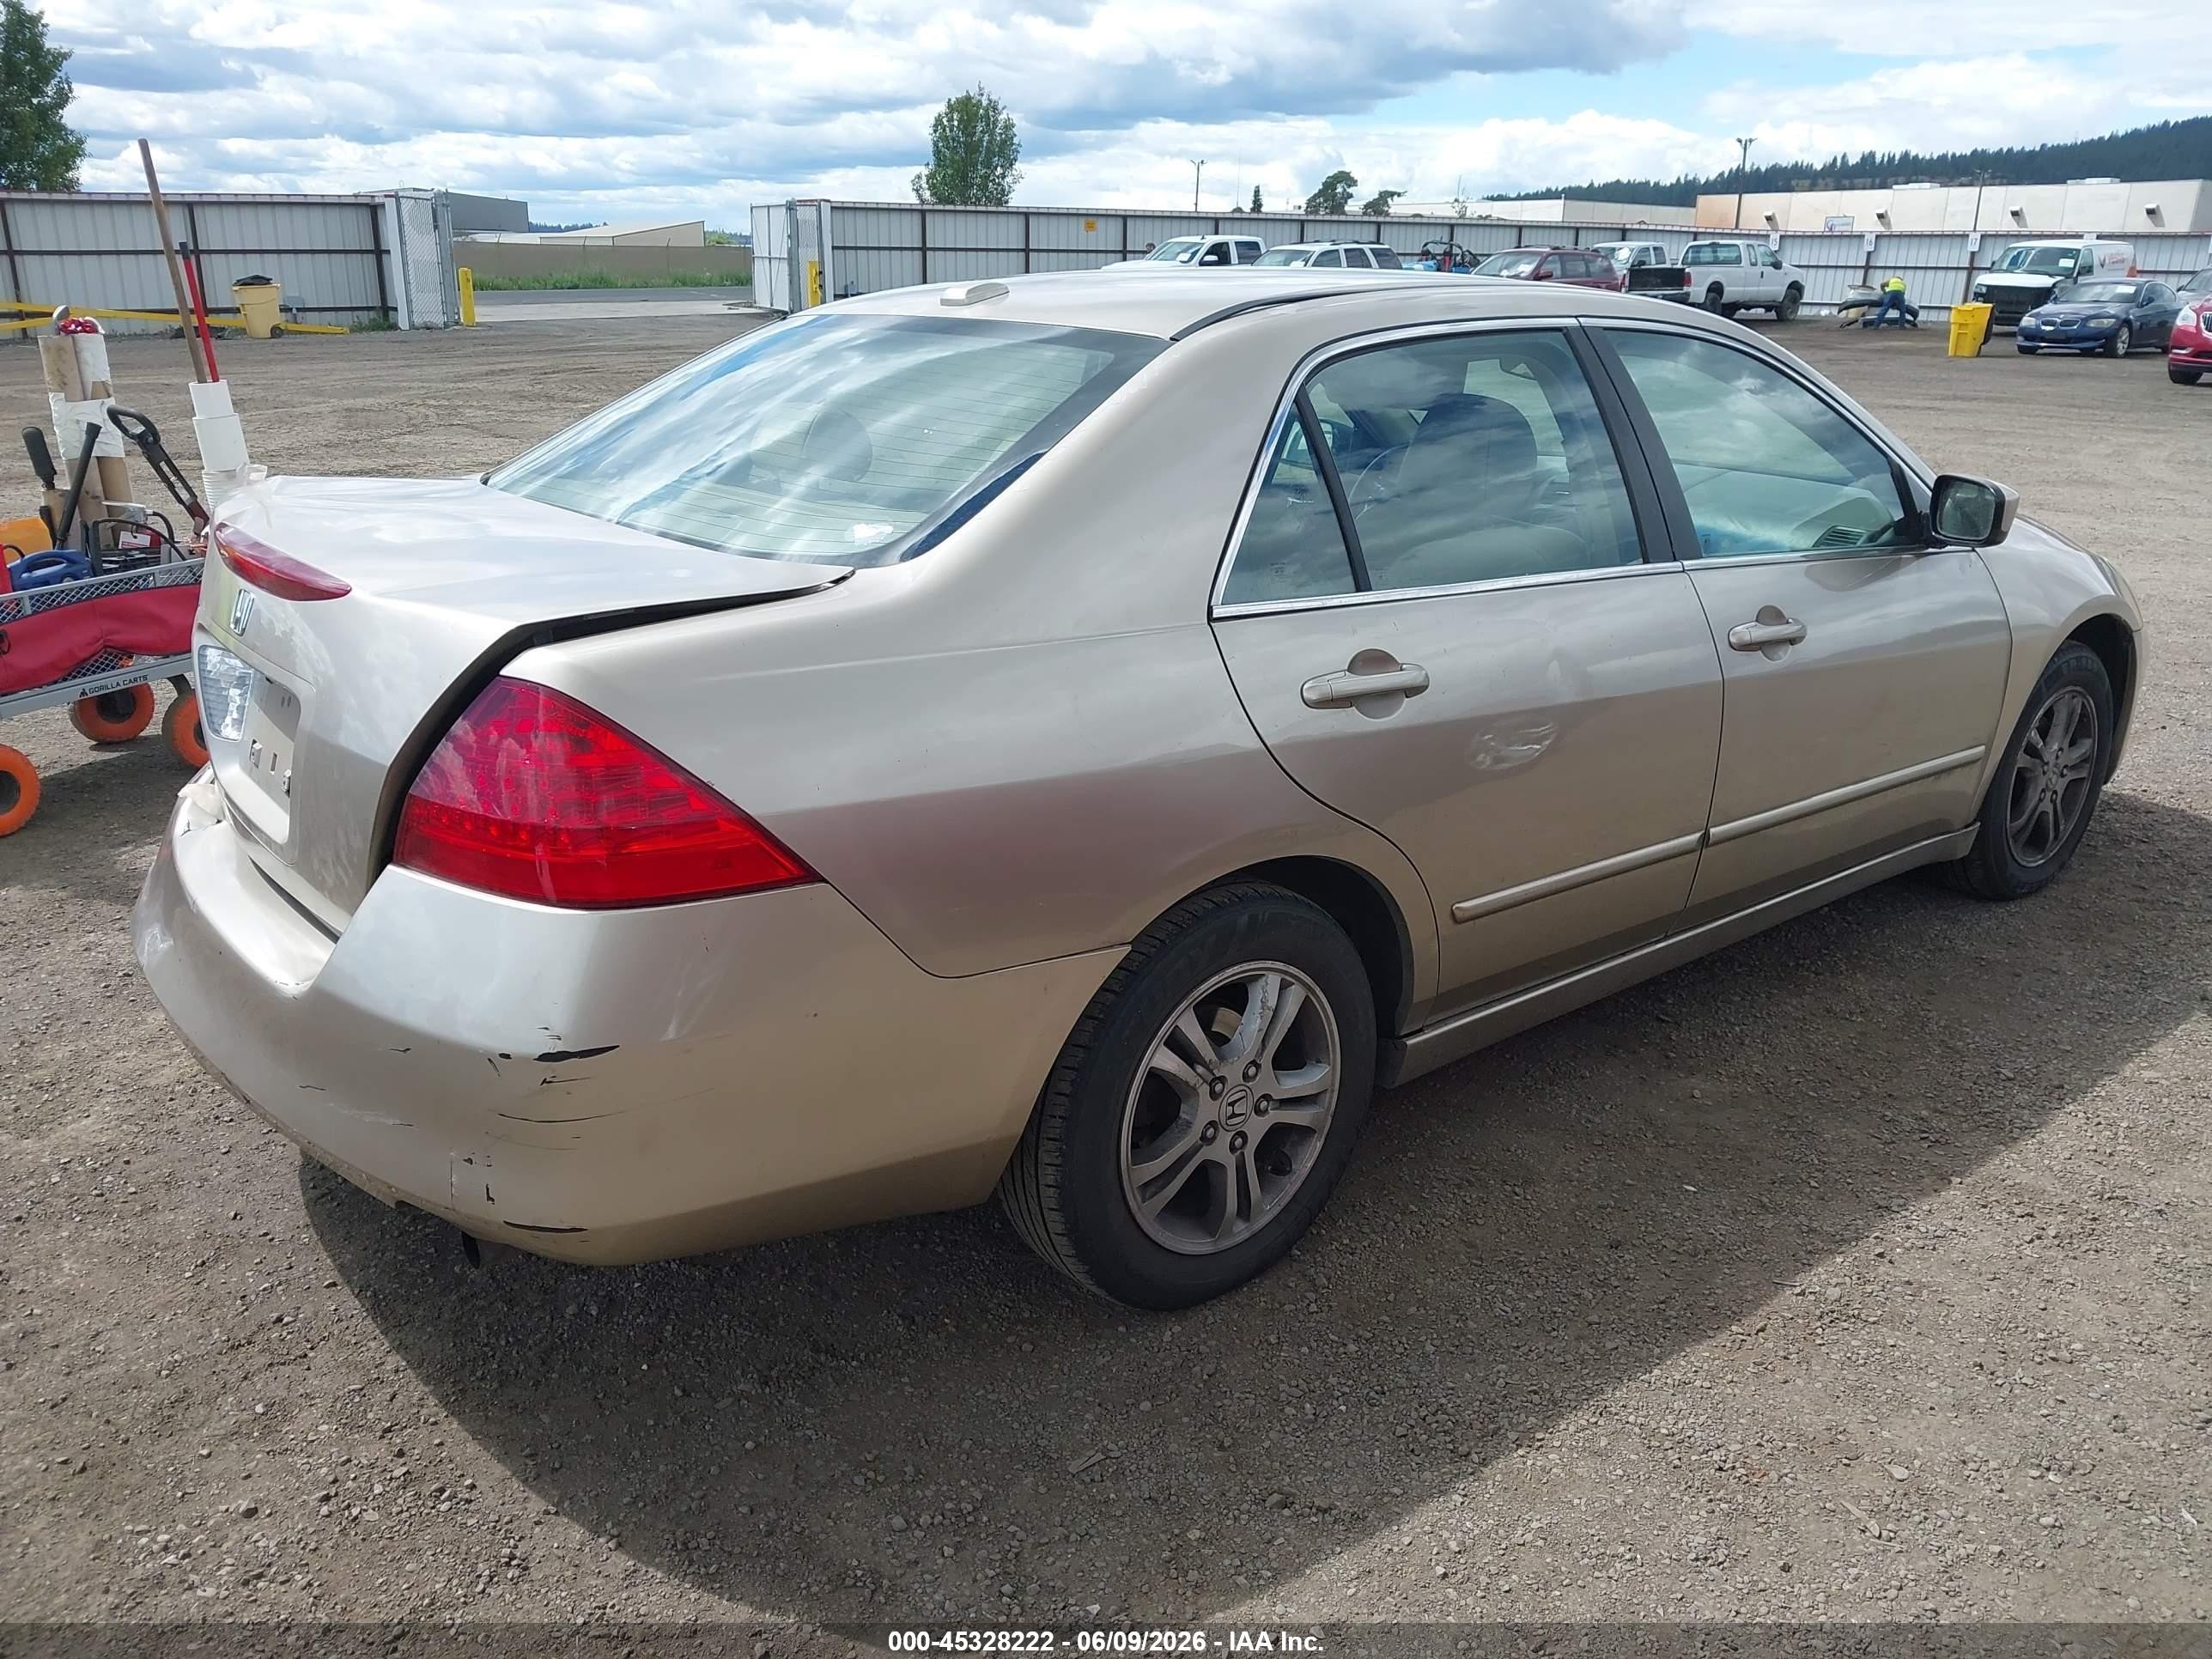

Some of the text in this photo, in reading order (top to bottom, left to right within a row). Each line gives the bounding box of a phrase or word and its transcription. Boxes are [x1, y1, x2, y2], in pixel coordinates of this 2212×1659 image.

[1771, 238, 1778, 246] 15
[1866, 238, 1874, 246] 16
[1970, 238, 1978, 247] 17
[88, 674, 149, 695] GORILLA CARTS
